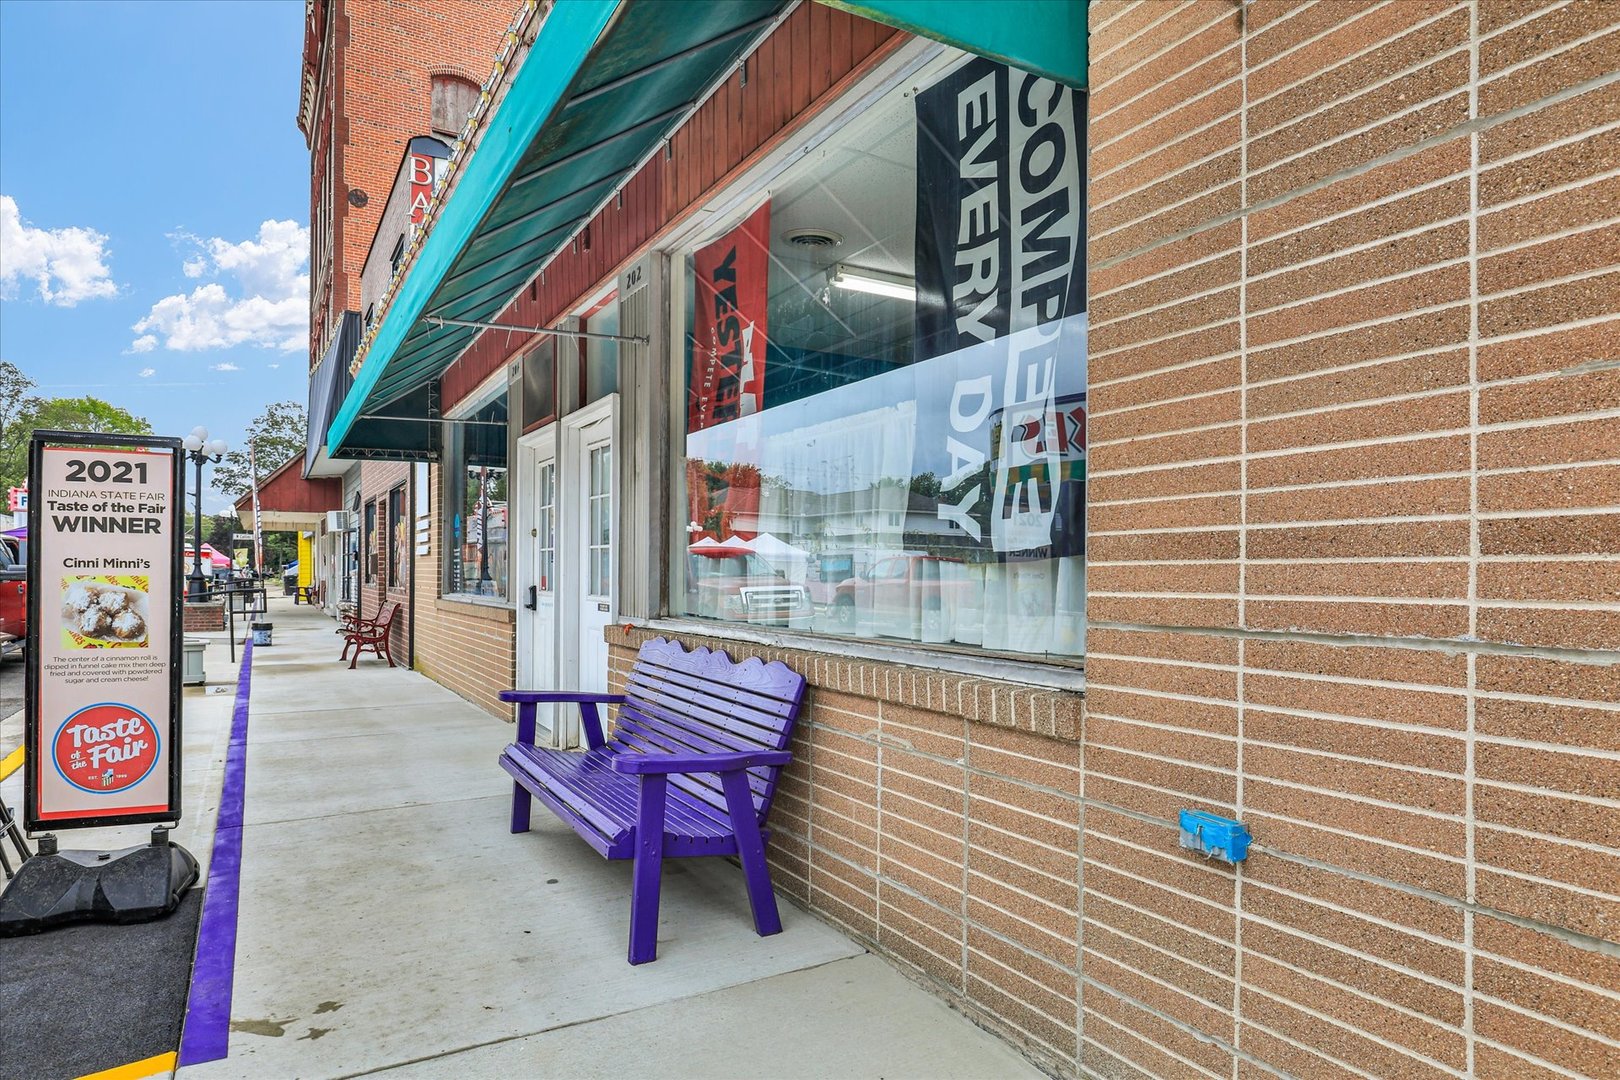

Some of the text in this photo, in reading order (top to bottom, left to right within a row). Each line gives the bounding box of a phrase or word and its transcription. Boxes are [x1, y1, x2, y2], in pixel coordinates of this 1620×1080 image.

[406, 155, 433, 238] BA
[626, 266, 642, 290] 202
[937, 70, 1000, 543] EVERY DAY
[65, 459, 148, 484] 2021
[48, 489, 165, 501] INDIANA STATE FAIR
[47, 500, 166, 514] Taste of the Fair
[51, 515, 161, 534] WINNER
[63, 557, 150, 569] Cinni Minni's
[127, 668, 162, 676] powdered
[148, 661, 166, 669] deep
[66, 717, 145, 748] Taste
[86, 737, 149, 769] Fair
